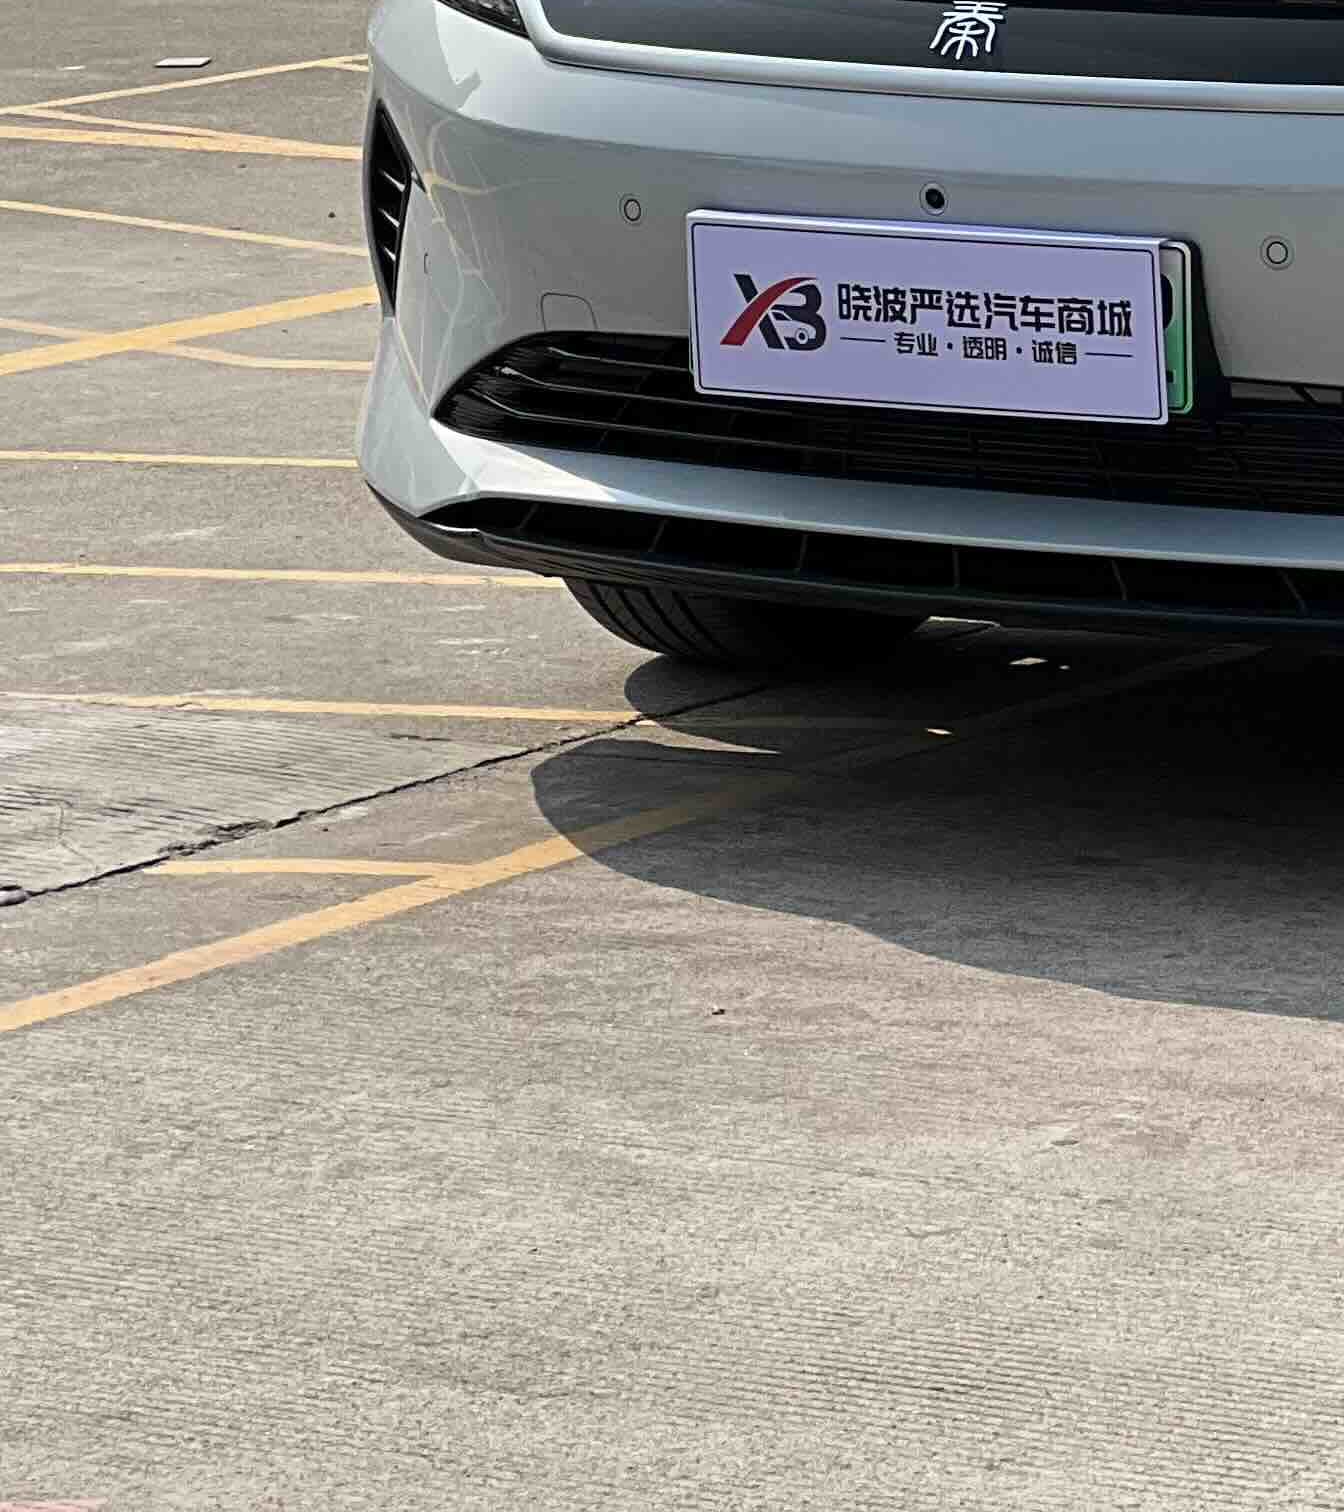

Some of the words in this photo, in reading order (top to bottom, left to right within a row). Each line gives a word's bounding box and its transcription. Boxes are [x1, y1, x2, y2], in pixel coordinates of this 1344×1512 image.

[837, 283, 1134, 338] 晓波严选汽车商城
